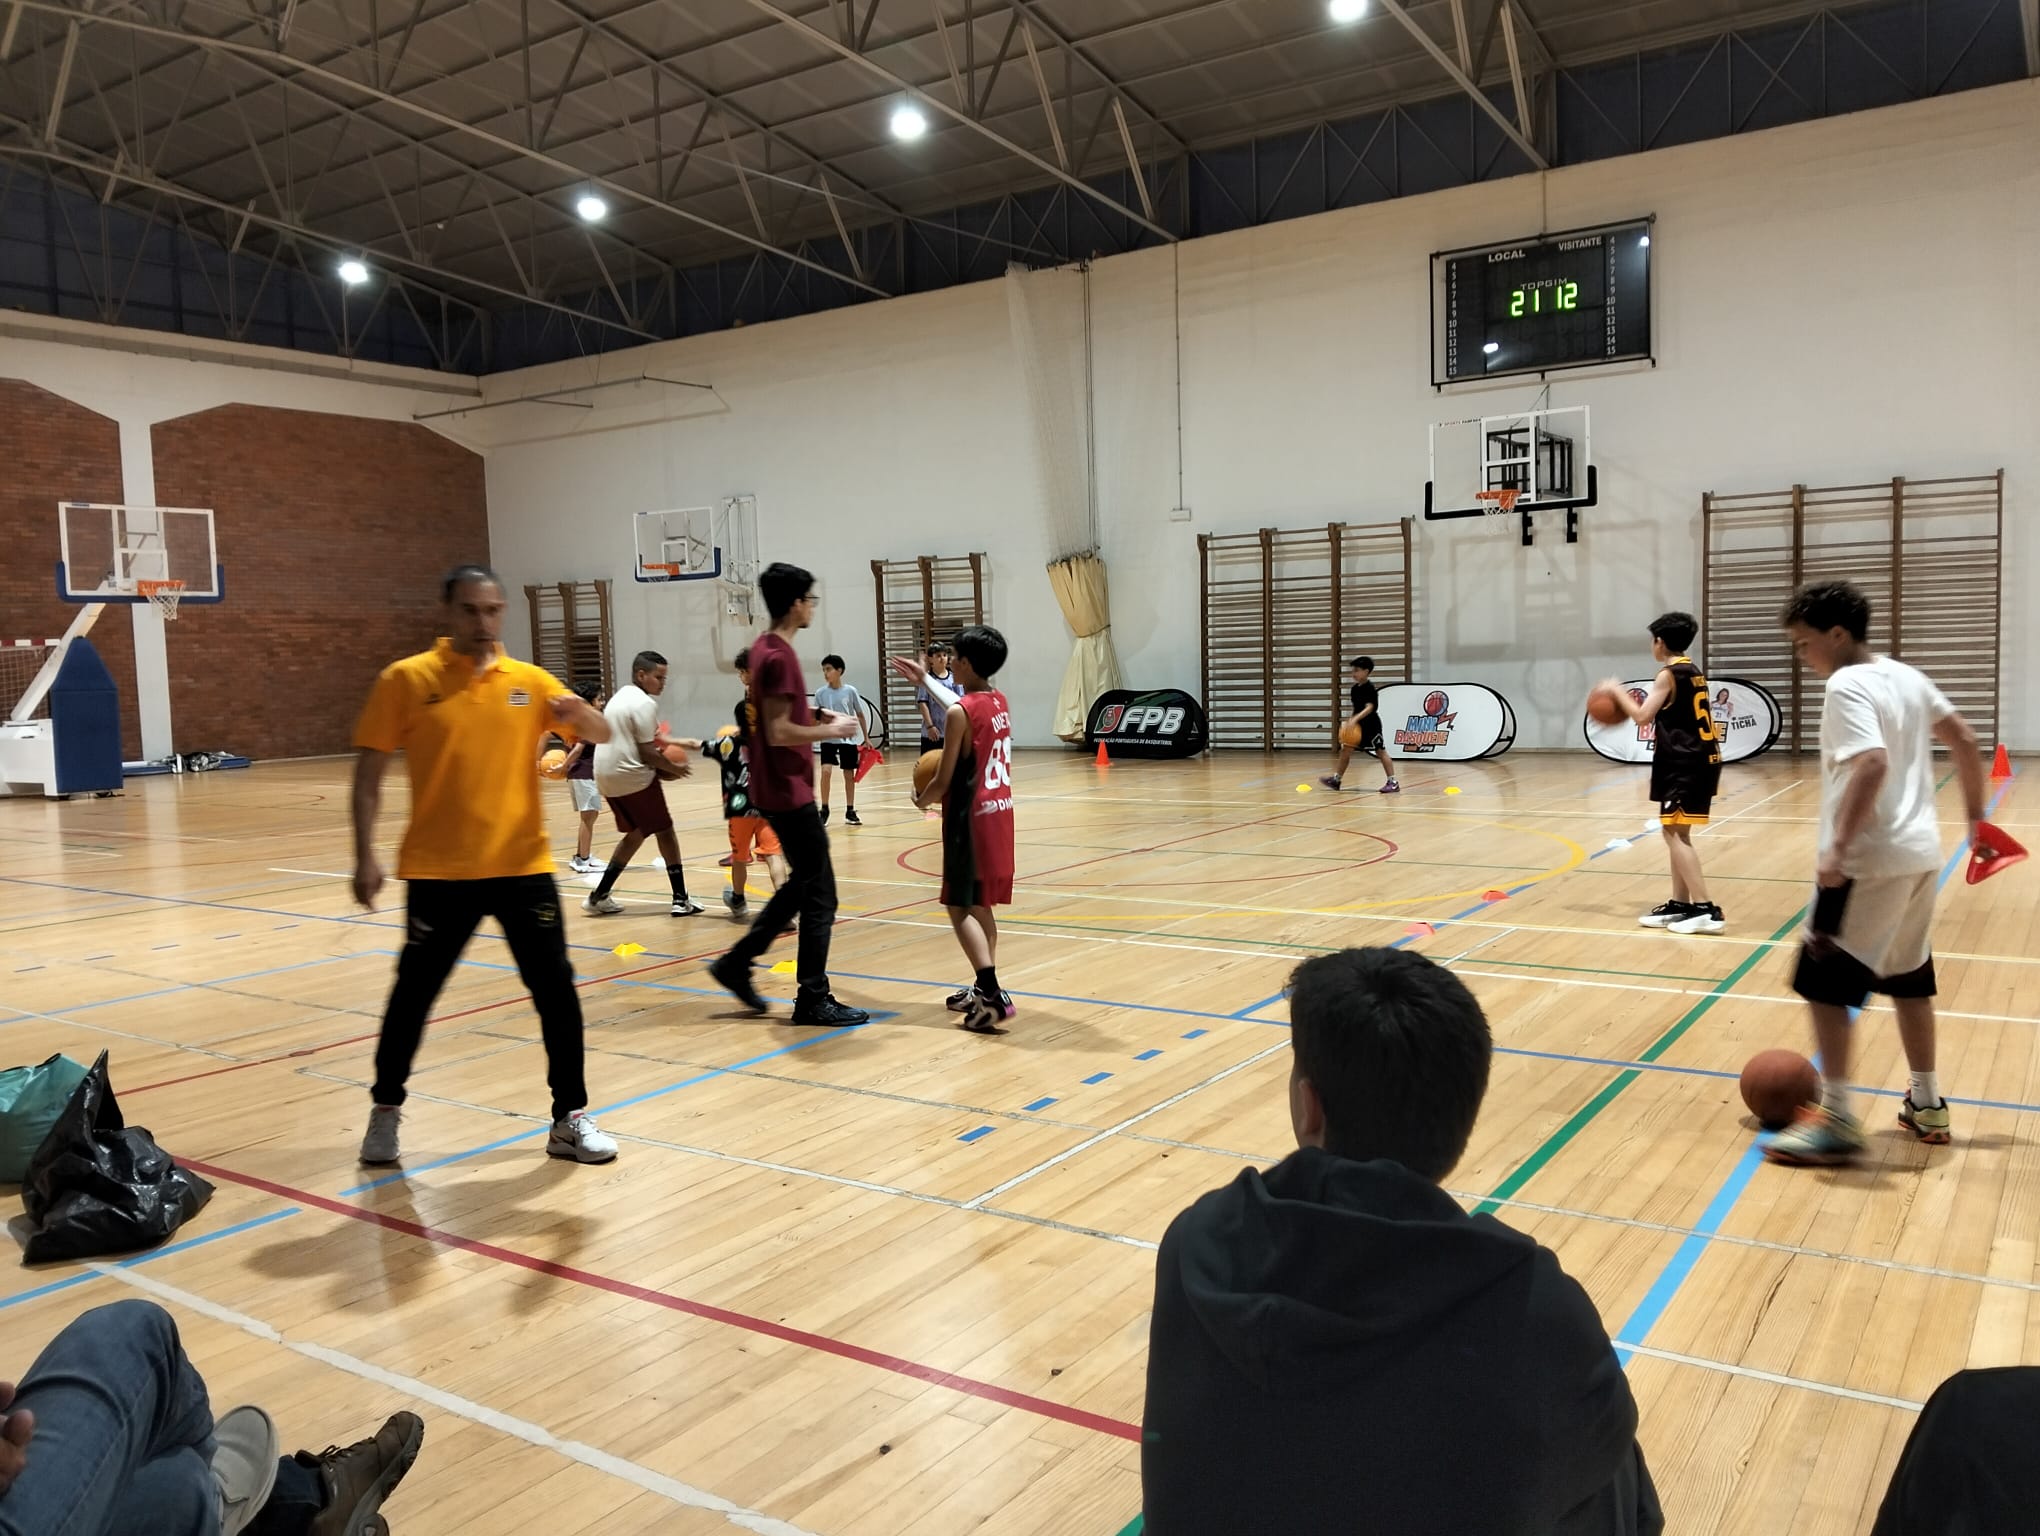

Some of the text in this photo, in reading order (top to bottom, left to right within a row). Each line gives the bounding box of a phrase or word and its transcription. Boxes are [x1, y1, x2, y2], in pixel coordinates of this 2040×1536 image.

[1559, 236, 1602, 251] VISITANTE
[1610, 236, 1615, 244] 4
[1610, 246, 1615, 254] 5
[1488, 249, 1526, 263] LOCAL
[1610, 256, 1615, 264] 6
[1451, 262, 1457, 270] 4
[1610, 266, 1616, 274] 7
[1452, 272, 1457, 280] 5
[1610, 276, 1615, 284] 8
[1451, 281, 1457, 289] 6
[1520, 277, 1568, 290] TOPGIM
[1610, 286, 1615, 295] 9
[1452, 291, 1457, 299] 7
[1451, 300, 1457, 308] 8
[1606, 296, 1616, 305] 10
[1606, 306, 1616, 314] 11
[1448, 320, 1457, 328] 10
[1606, 316, 1616, 325] 12
[1448, 329, 1457, 337] 11
[1448, 339, 1457, 347] 12
[1606, 336, 1616, 345] 14
[1606, 346, 1616, 355] 15
[1448, 357, 1457, 366] 14
[1448, 366, 1457, 375] 15
[1117, 705, 1185, 734] FPB
[1731, 718, 1757, 730] TICHA
[1395, 730, 1449, 746] BASQUETE
